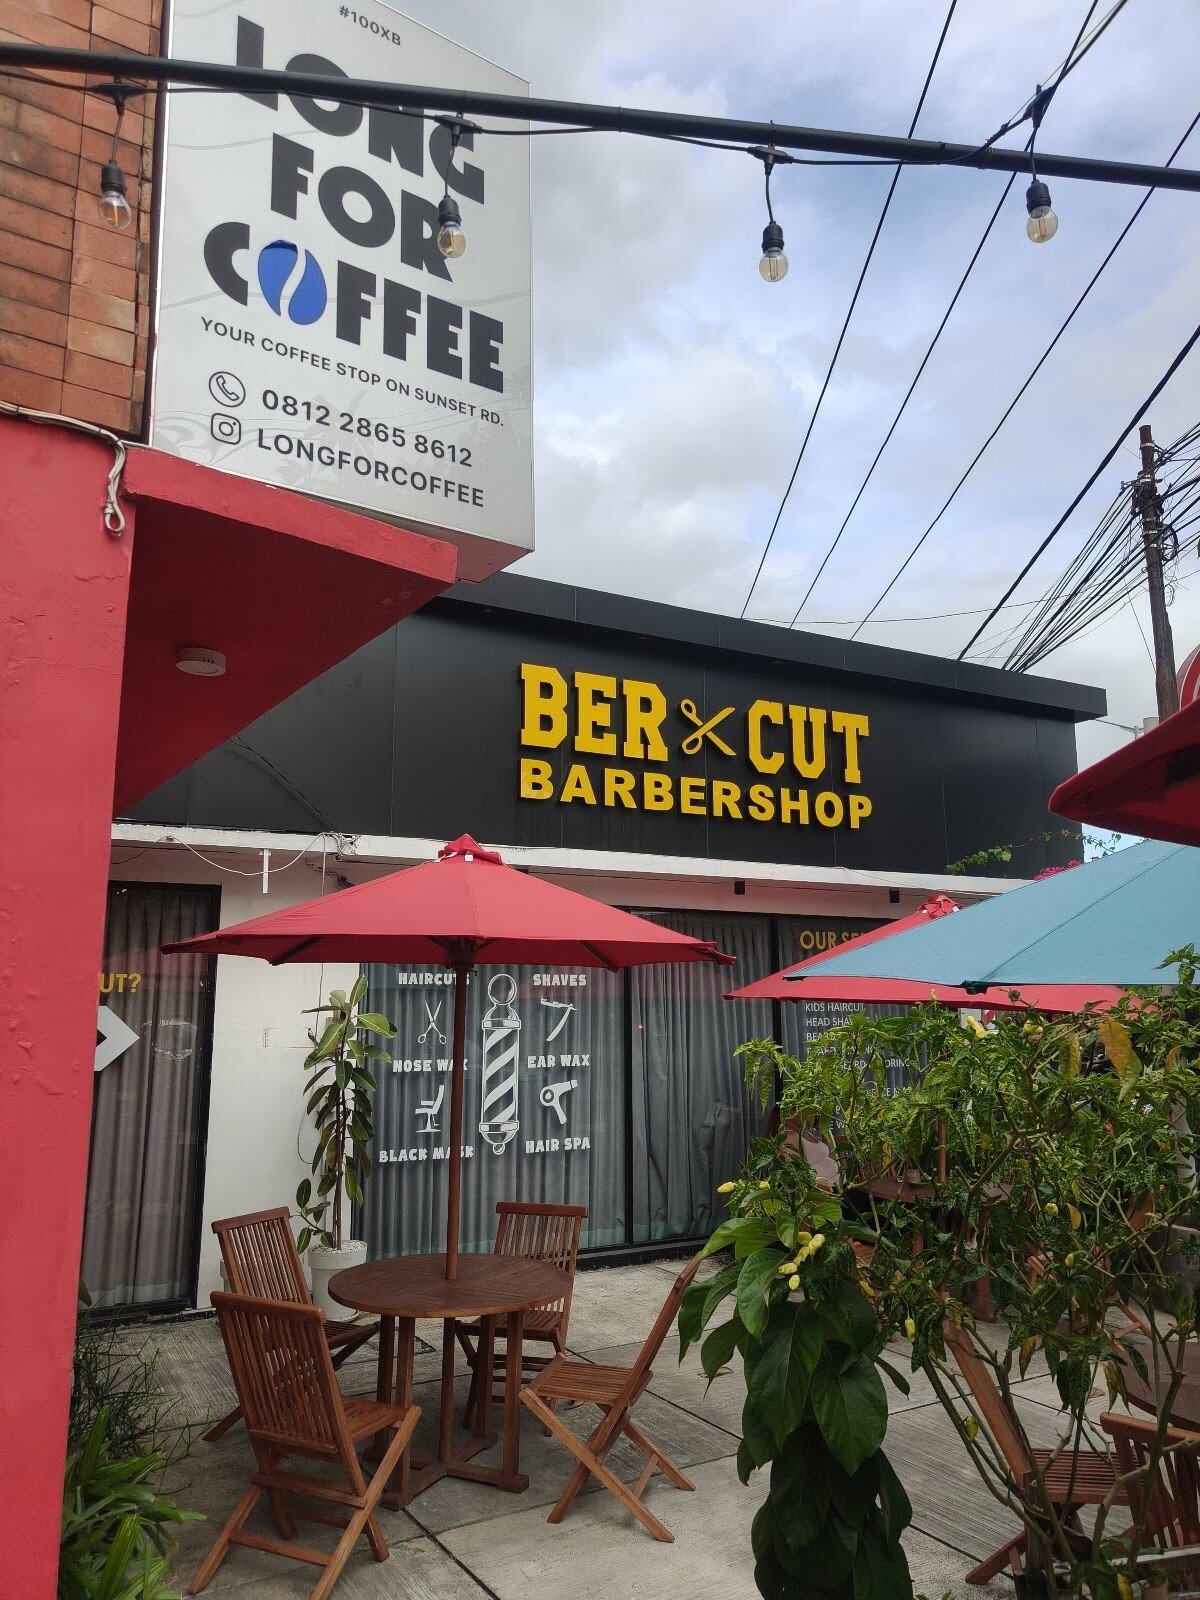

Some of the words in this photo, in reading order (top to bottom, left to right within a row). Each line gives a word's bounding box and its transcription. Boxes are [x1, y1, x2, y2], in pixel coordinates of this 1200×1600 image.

[339, 5, 402, 46] #100XB
[270, 132, 454, 283] FOR
[201, 316, 256, 347] YOUR
[261, 337, 331, 372] COFFEE
[336, 362, 381, 386] STOP
[386, 378, 411, 397] ON
[414, 387, 477, 419] SUNSET
[481, 408, 504, 427] RD.
[261, 389, 331, 427] 0812
[339, 411, 407, 448] 2865
[414, 433, 473, 468] 8612
[257, 427, 484, 508] LONGFORCOFFEE
[520, 663, 668, 762] BER
[748, 699, 869, 784] CUT
[520, 758, 872, 829] BARBERSHOP
[800, 930, 837, 950] OUR
[100, 972, 142, 993] UT?
[533, 973, 587, 986] SHAVES
[805, 1002, 825, 1012] KIDS
[827, 1002, 865, 1012] HAIRCUT
[806, 1017, 831, 1027] HEAD
[393, 1059, 432, 1073] NOSE
[527, 1055, 556, 1069] EAR
[560, 1054, 590, 1067] WAX
[379, 1148, 428, 1163] BLACK
[525, 1139, 559, 1154] HAIR
[564, 1137, 590, 1151] SPA
